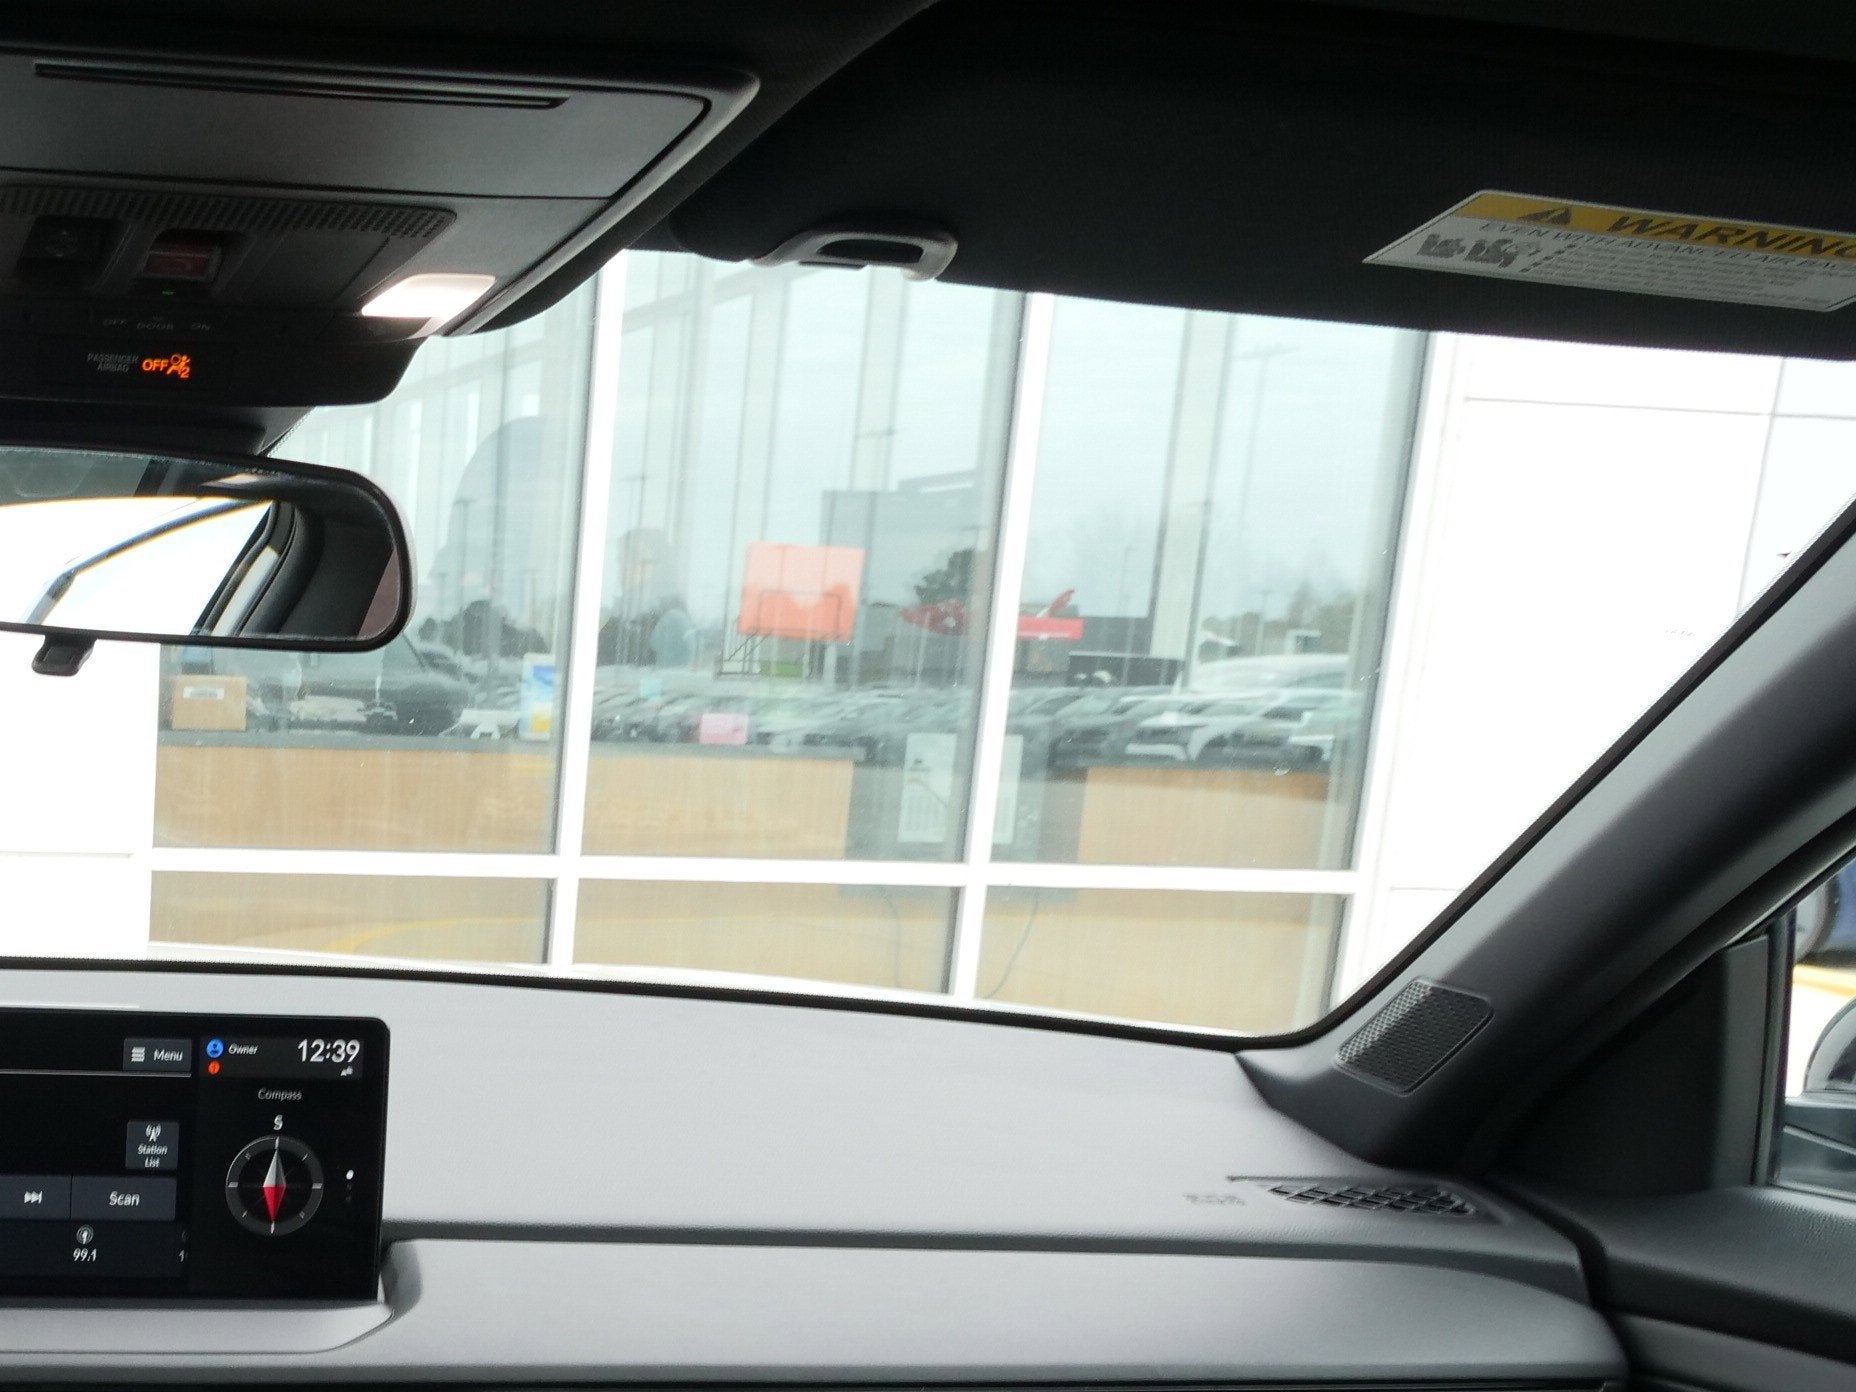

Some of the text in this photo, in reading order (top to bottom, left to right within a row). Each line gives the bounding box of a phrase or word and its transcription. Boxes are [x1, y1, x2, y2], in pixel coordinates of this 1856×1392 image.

[87, 353, 140, 364] PASSENGER
[141, 358, 168, 372] OFF
[153, 1049, 183, 1062] Menu
[227, 1043, 259, 1055] Owner
[297, 1038, 361, 1063] 12:39
[257, 1087, 303, 1102] Compass
[273, 1114, 284, 1131] S
[137, 1144, 168, 1156] Station
[144, 1157, 161, 1168] List
[108, 1191, 140, 1207] Scan
[72, 1248, 98, 1262] 99.1
